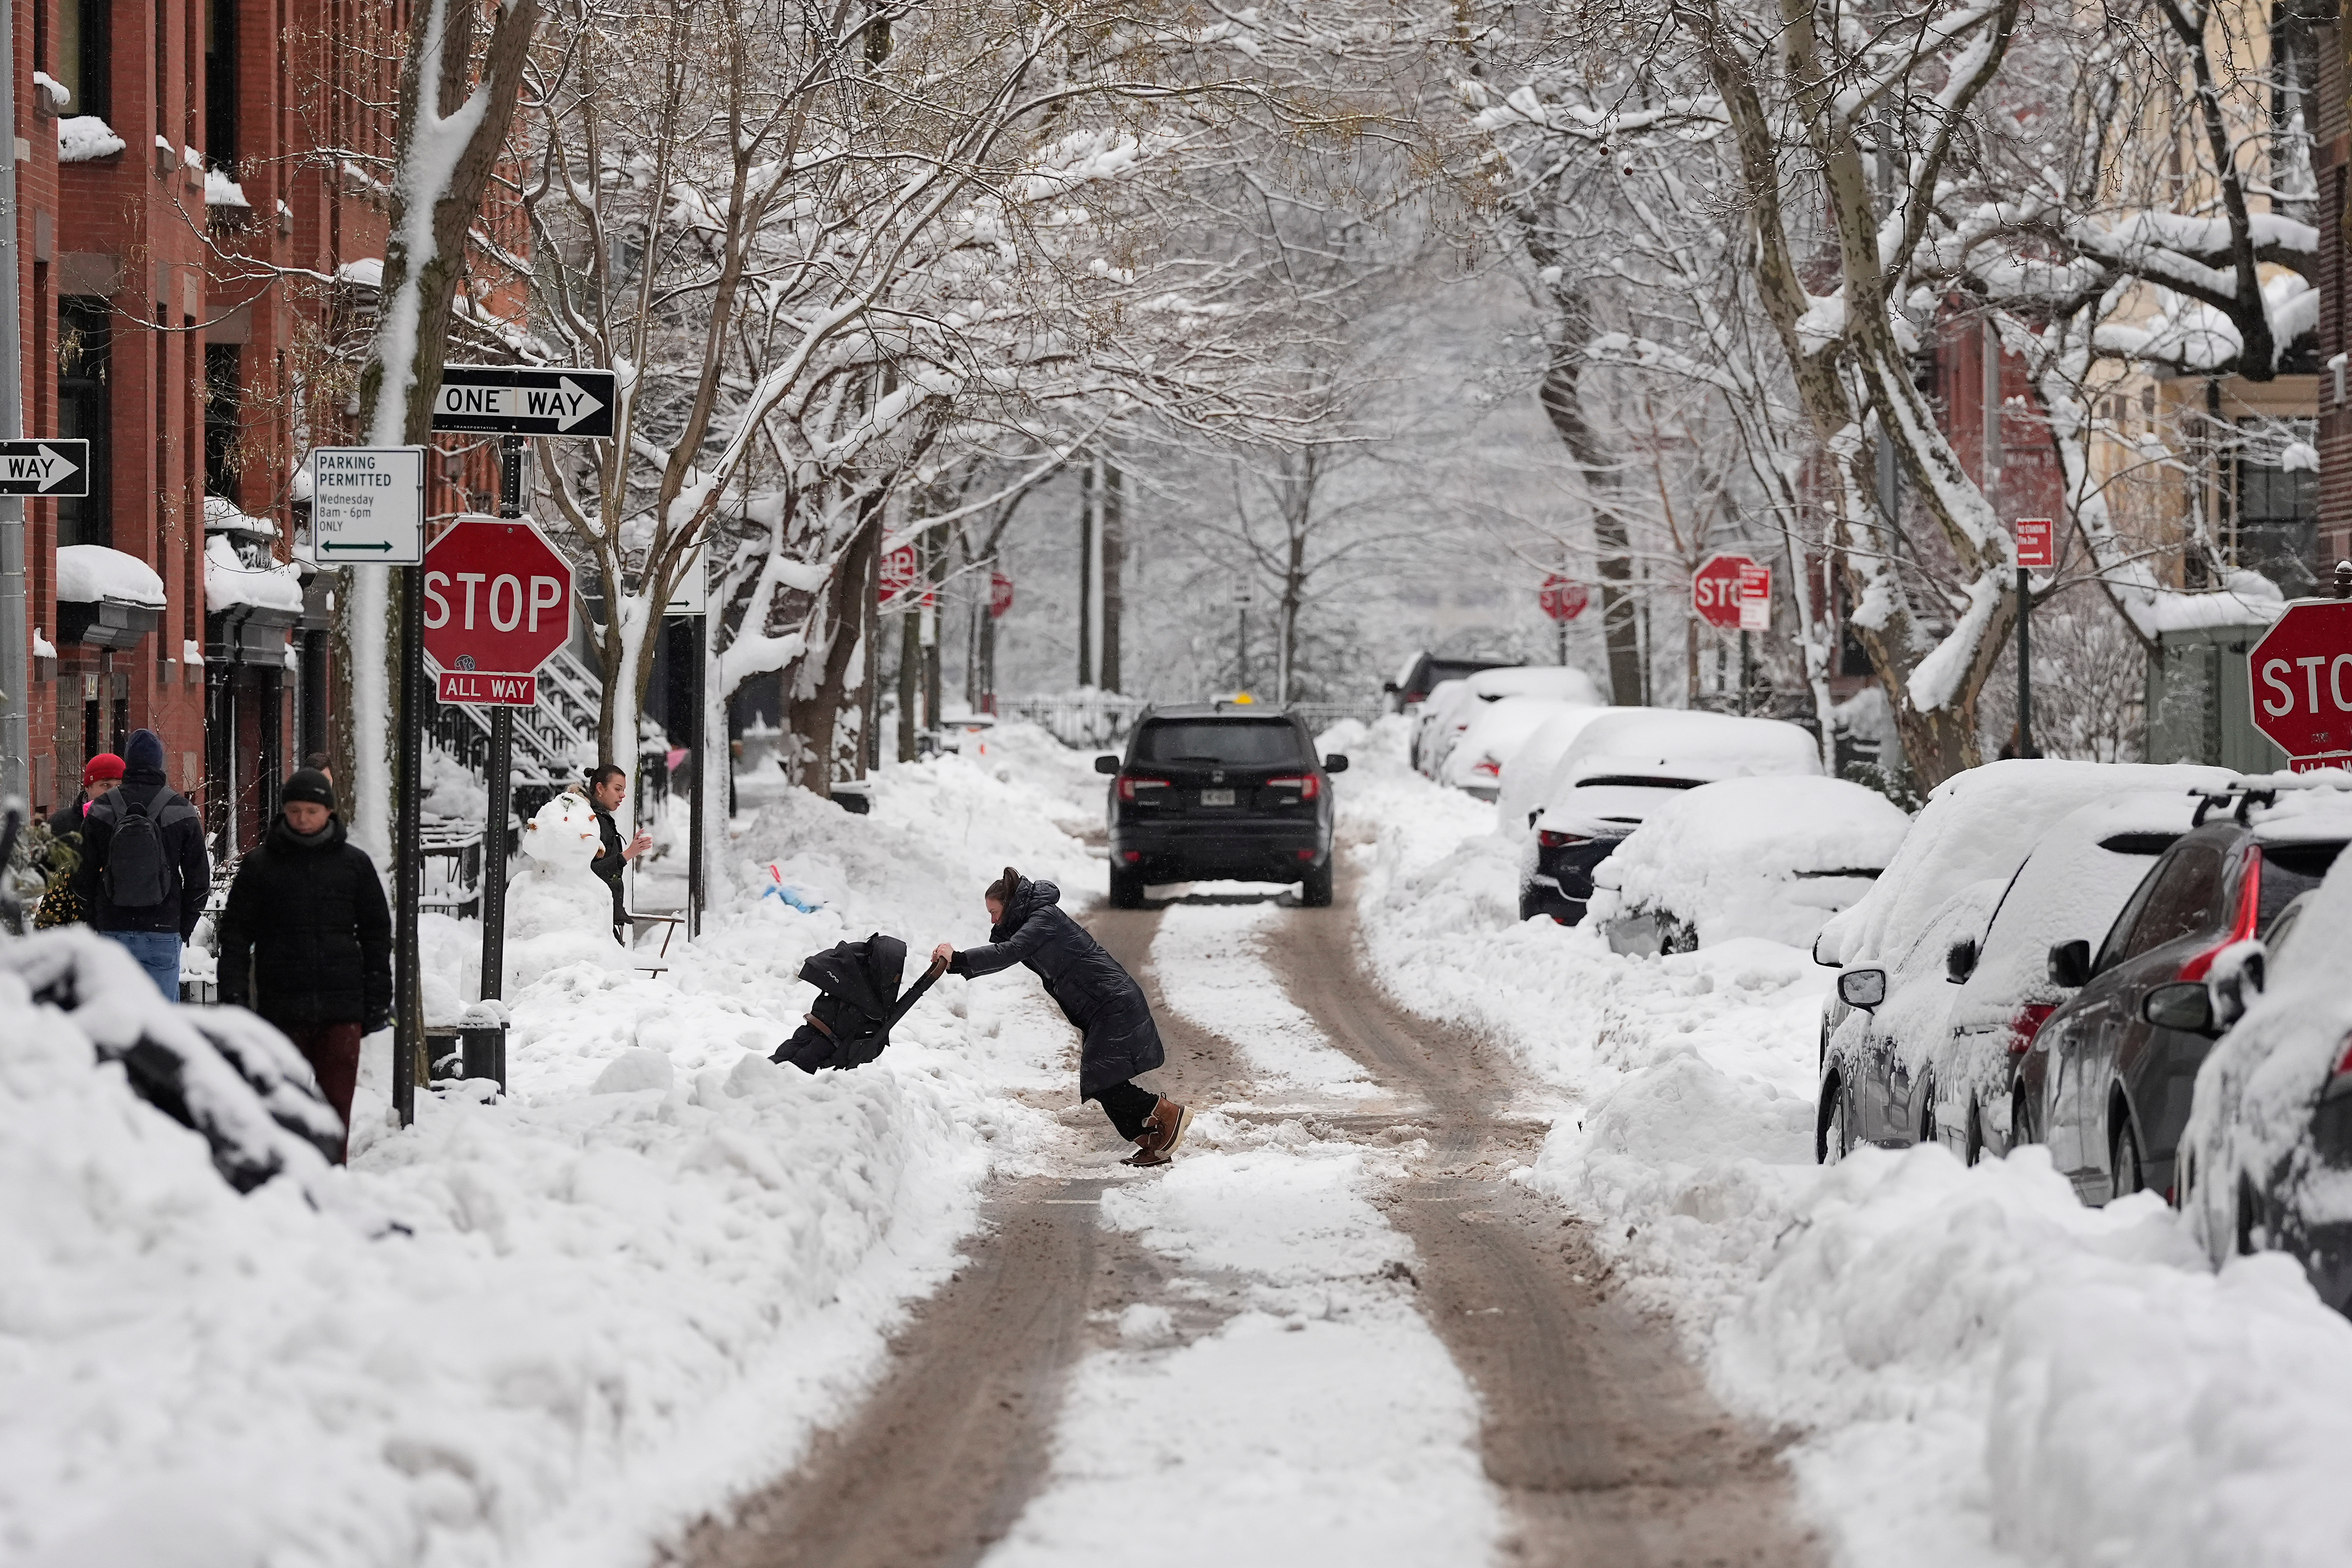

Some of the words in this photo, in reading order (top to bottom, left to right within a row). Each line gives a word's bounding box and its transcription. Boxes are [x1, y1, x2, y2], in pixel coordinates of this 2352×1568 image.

[446, 388, 500, 413] ONE
[528, 391, 584, 416] WAY
[8, 458, 55, 478] WAY
[320, 456, 375, 469] PARKING
[320, 473, 391, 486] PERMITTED
[320, 493, 374, 506] Wednesday
[320, 507, 340, 517] 8am
[350, 507, 371, 519] 6pm
[320, 521, 343, 531] ONLY
[424, 570, 562, 632] STOP
[1540, 588, 1586, 607] SOP
[1697, 577, 1741, 608] STO
[446, 677, 481, 697] ALL
[491, 680, 529, 698] WAY
[2262, 653, 2352, 717] STO
[826, 971, 840, 983] nuna
